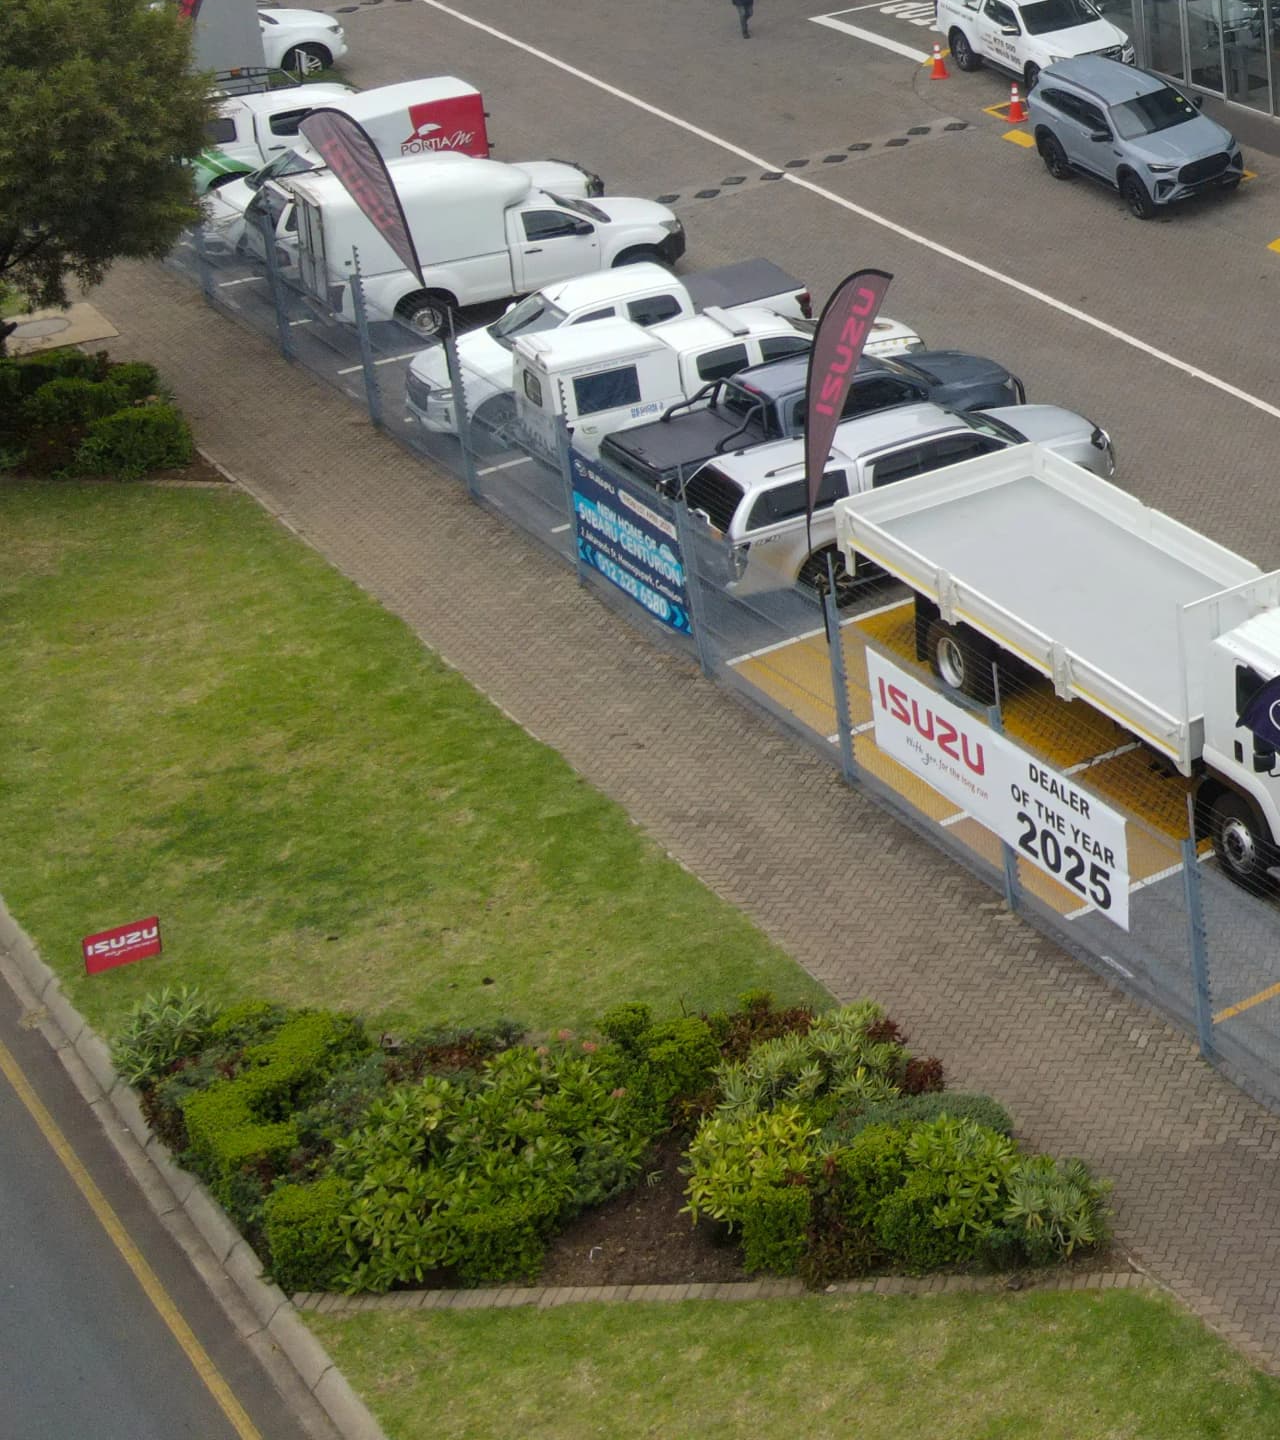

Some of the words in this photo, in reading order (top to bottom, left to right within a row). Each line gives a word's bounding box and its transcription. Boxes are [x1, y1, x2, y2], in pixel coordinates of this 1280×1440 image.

[400, 136, 451, 155] PORTIA
[815, 287, 877, 417] ISUZU
[579, 503, 618, 544] SUBARU
[620, 530, 682, 588] CENTURION
[878, 676, 985, 777] ISUZU
[1011, 783, 1030, 808] OF
[1034, 799, 1066, 833] THE
[1071, 823, 1116, 869] YEAR
[1028, 763, 1091, 820] DEALER
[1017, 811, 1113, 911] 2025
[87, 925, 159, 957] ISUZU
